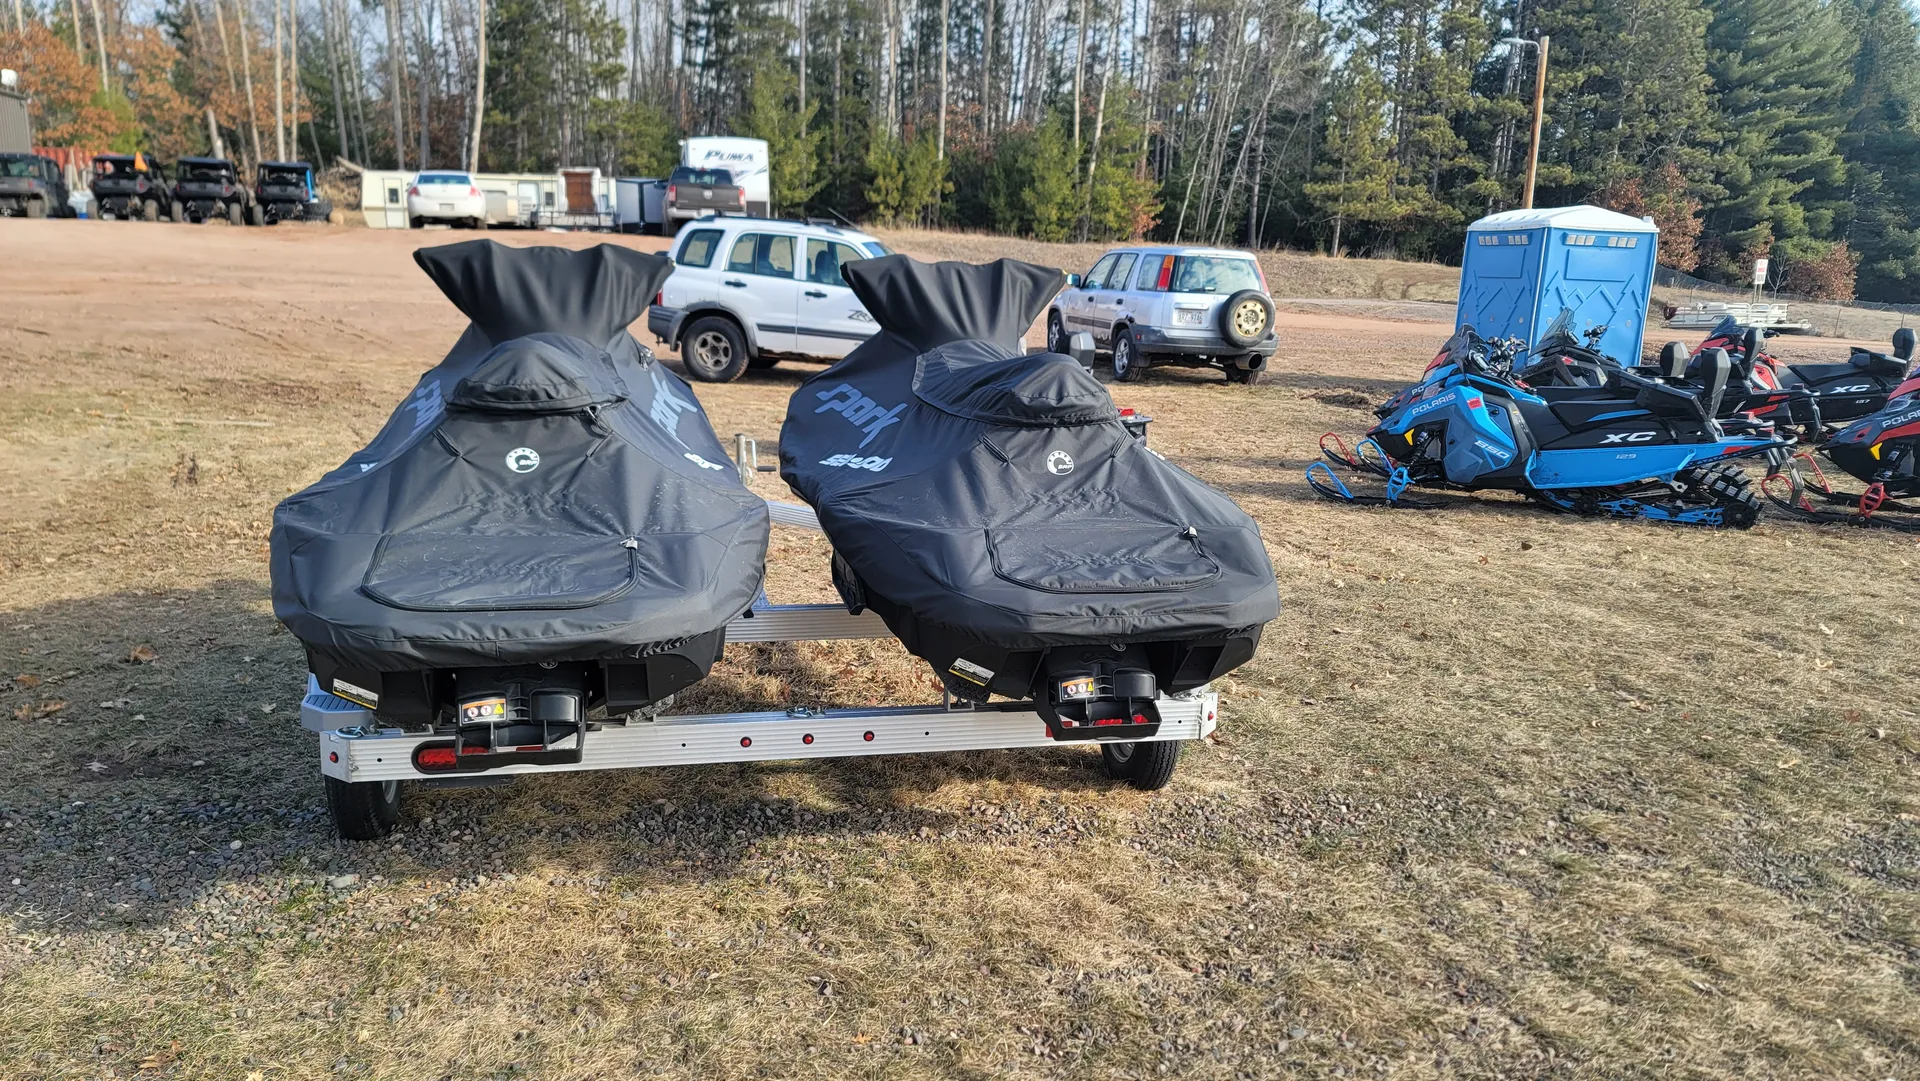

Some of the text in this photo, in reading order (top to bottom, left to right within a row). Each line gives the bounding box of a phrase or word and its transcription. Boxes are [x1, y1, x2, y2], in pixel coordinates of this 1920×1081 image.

[703, 149, 754, 162] PUMA
[1830, 384, 1871, 394] XC
[1412, 392, 1456, 415] POLARIS
[1599, 431, 1657, 444] XC
[1474, 439, 1510, 459] 850
